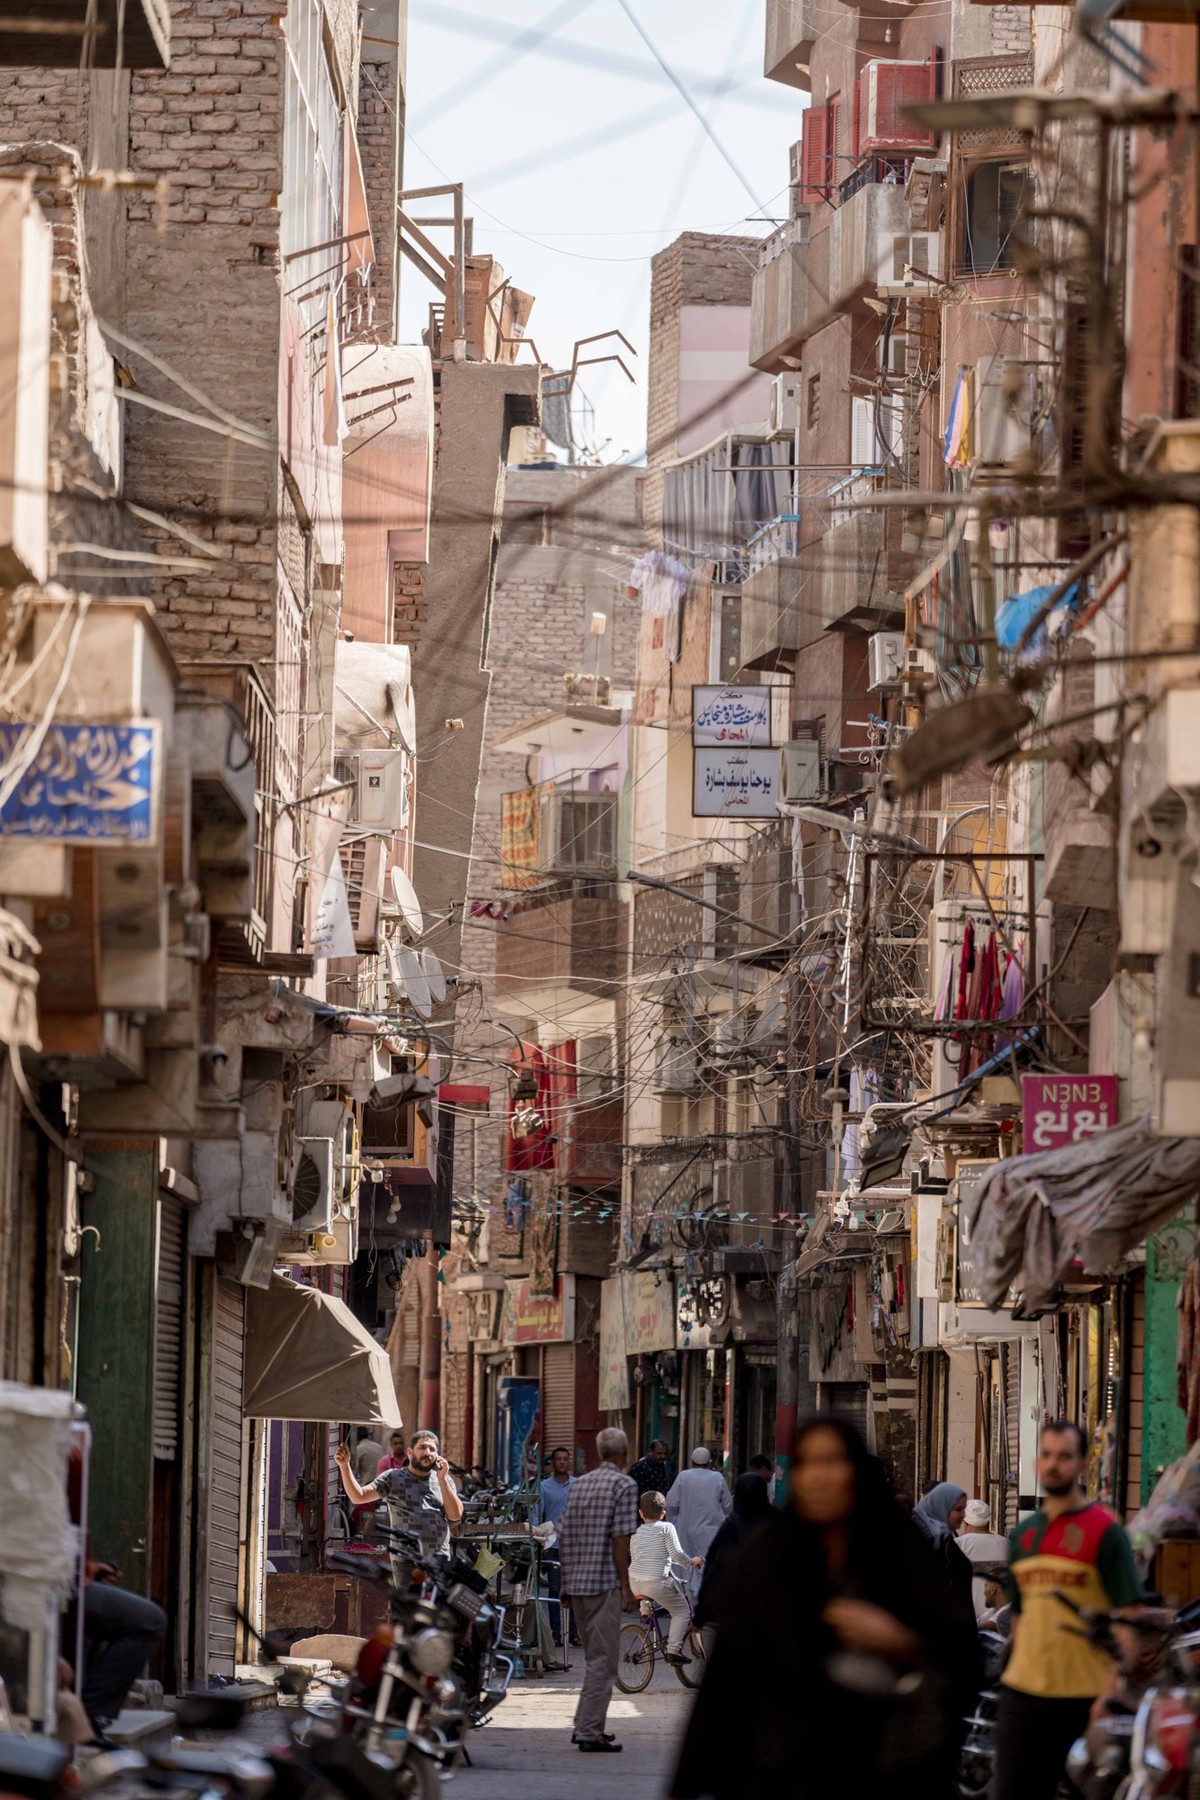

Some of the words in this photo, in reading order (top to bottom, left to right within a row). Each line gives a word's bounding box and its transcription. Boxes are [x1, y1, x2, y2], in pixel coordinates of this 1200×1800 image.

[719, 691, 743, 702] مكتب
[725, 703, 748, 725] بشارة
[732, 708, 767, 725] يوسف
[726, 756, 748, 766] مكتب
[705, 767, 725, 792] بشارة
[726, 769, 748, 794] يوسف
[750, 769, 772, 794] يوحنا
